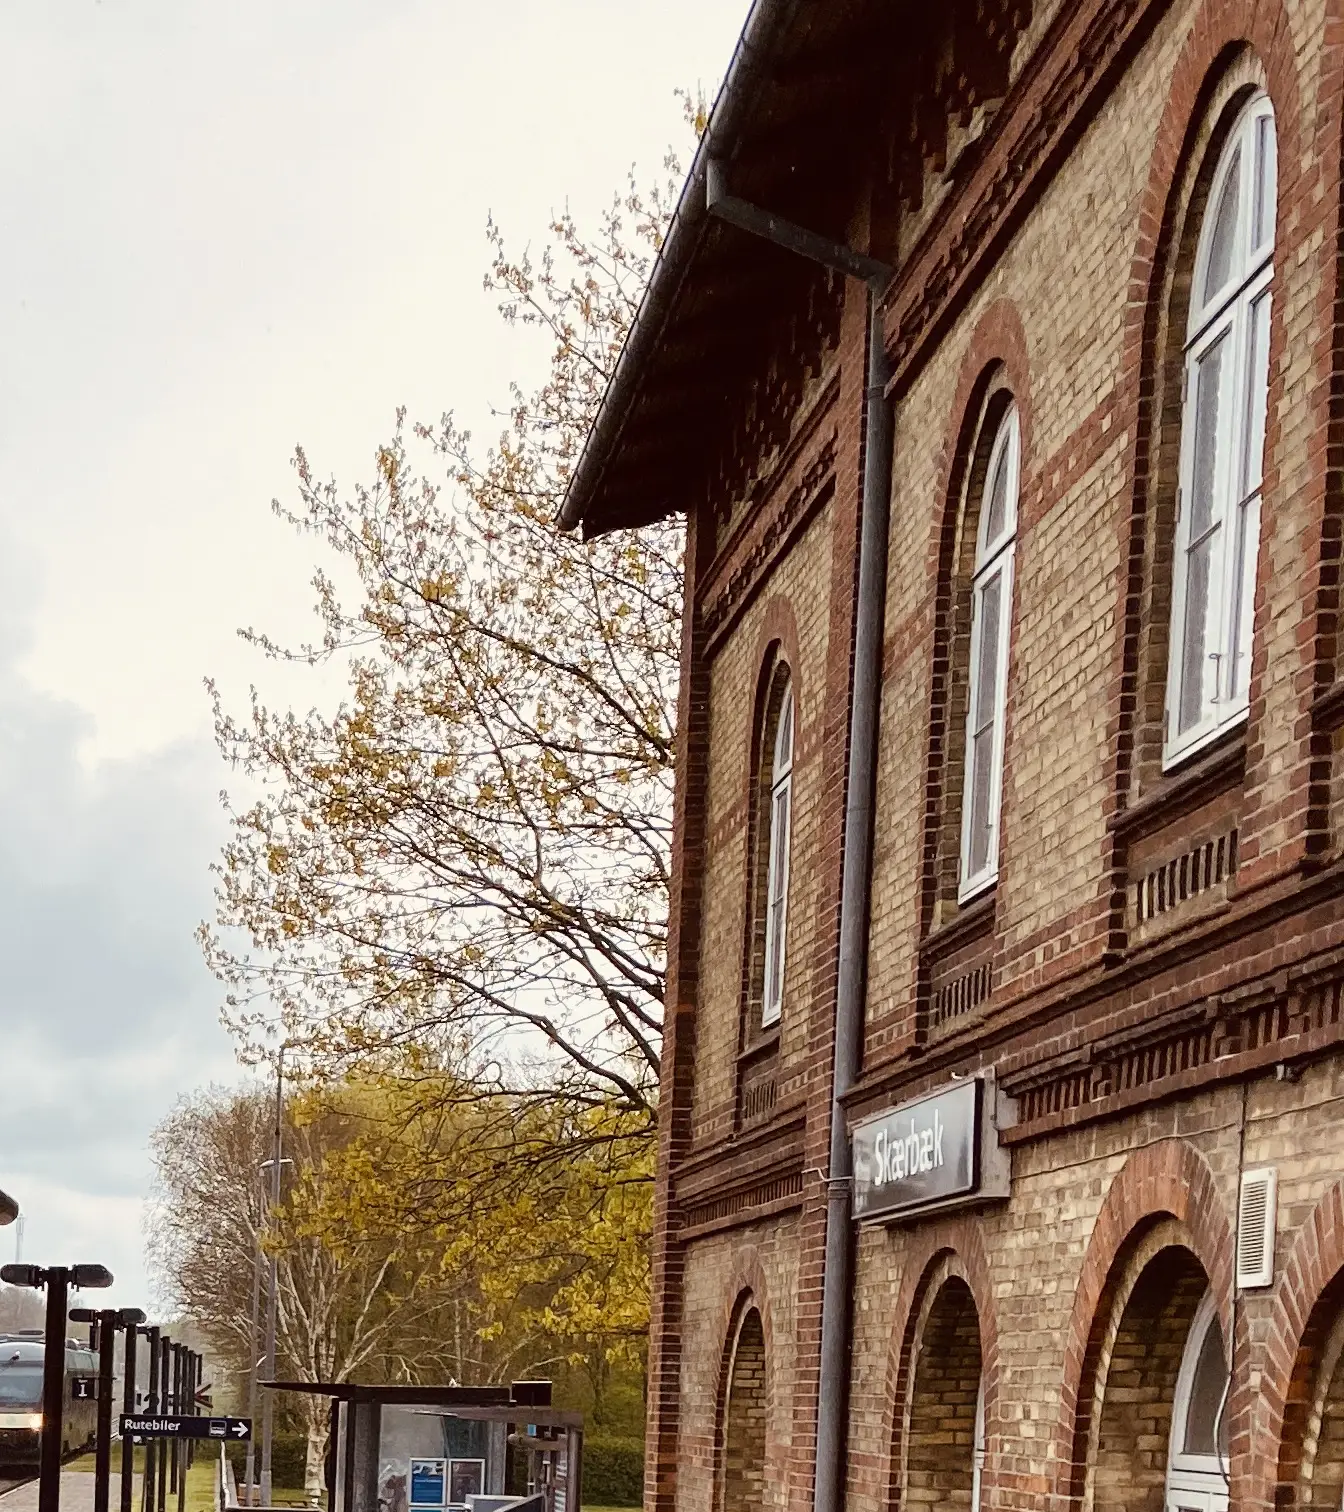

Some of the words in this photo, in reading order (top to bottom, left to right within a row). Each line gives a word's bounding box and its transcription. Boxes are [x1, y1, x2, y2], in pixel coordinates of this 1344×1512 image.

[873, 1108, 944, 1186] Skærbæk
[78, 1384, 88, 1397] 1
[124, 1418, 181, 1431] Rutebiler
